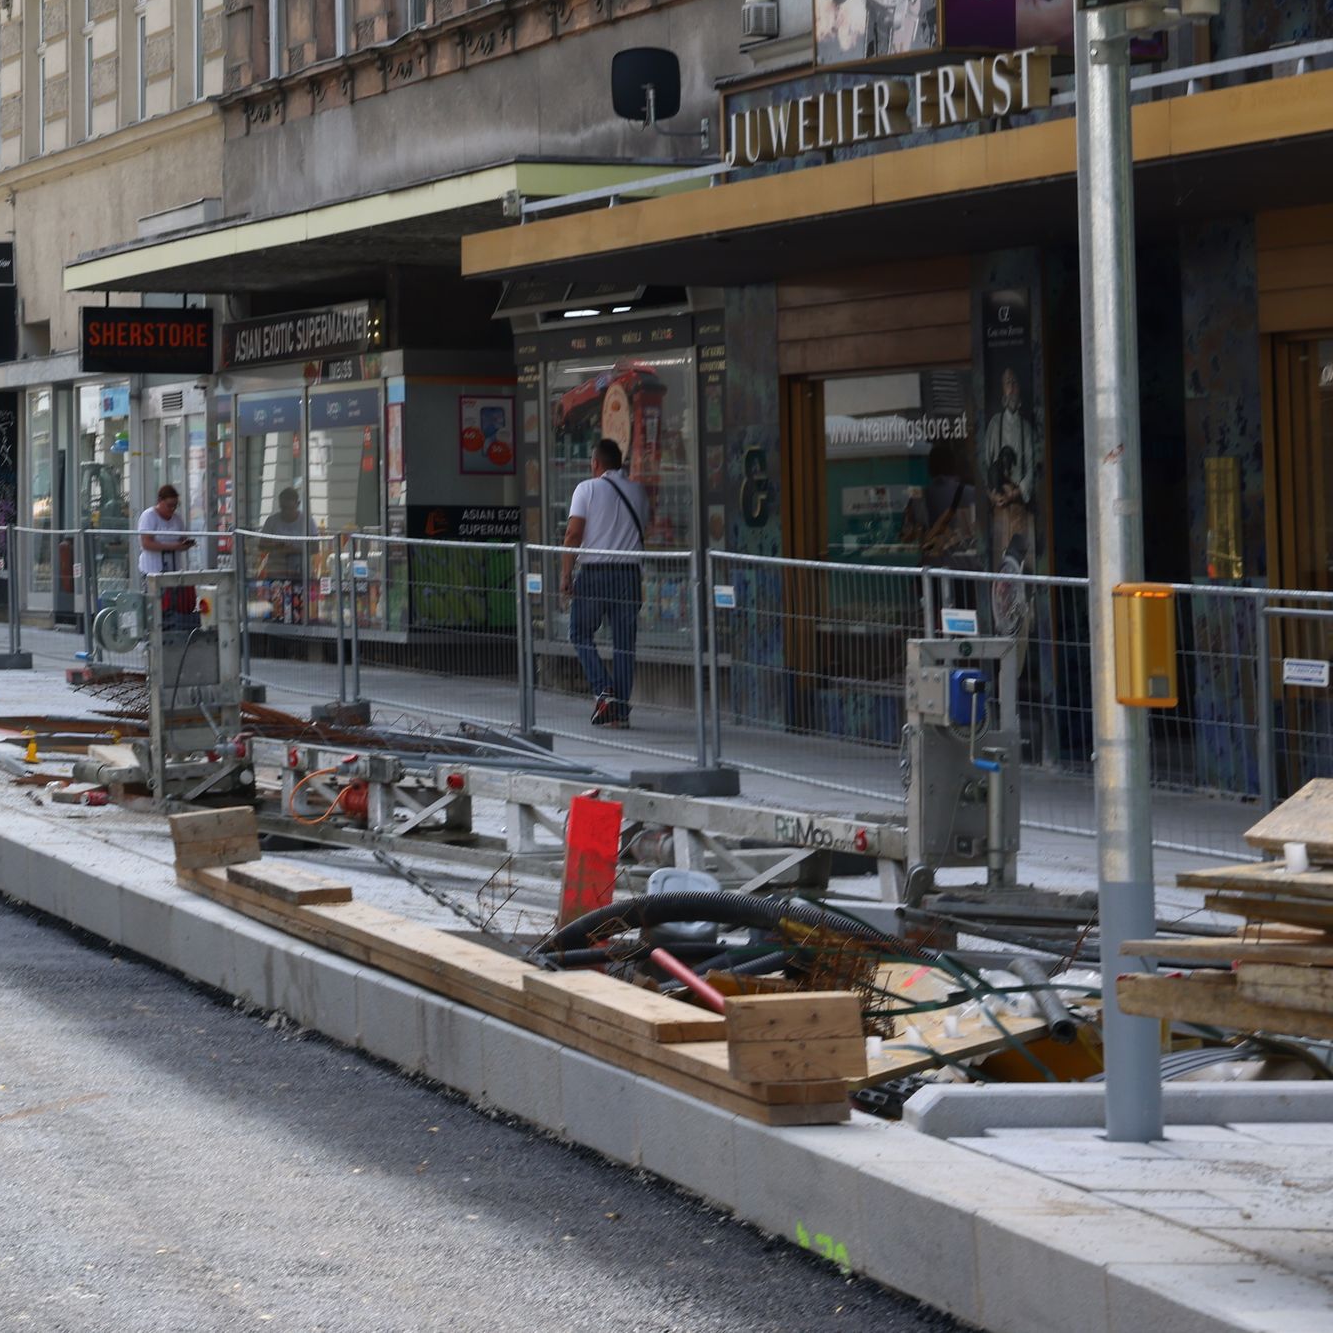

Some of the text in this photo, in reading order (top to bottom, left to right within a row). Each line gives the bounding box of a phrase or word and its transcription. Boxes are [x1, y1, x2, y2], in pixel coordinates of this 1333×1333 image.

[725, 47, 1037, 168] JUWELIER ERNST
[88, 321, 208, 347] SHERSTORE
[234, 305, 369, 363] ASIAN EXOTIC SUPERMARKET
[461, 509, 495, 521] ASIAN
